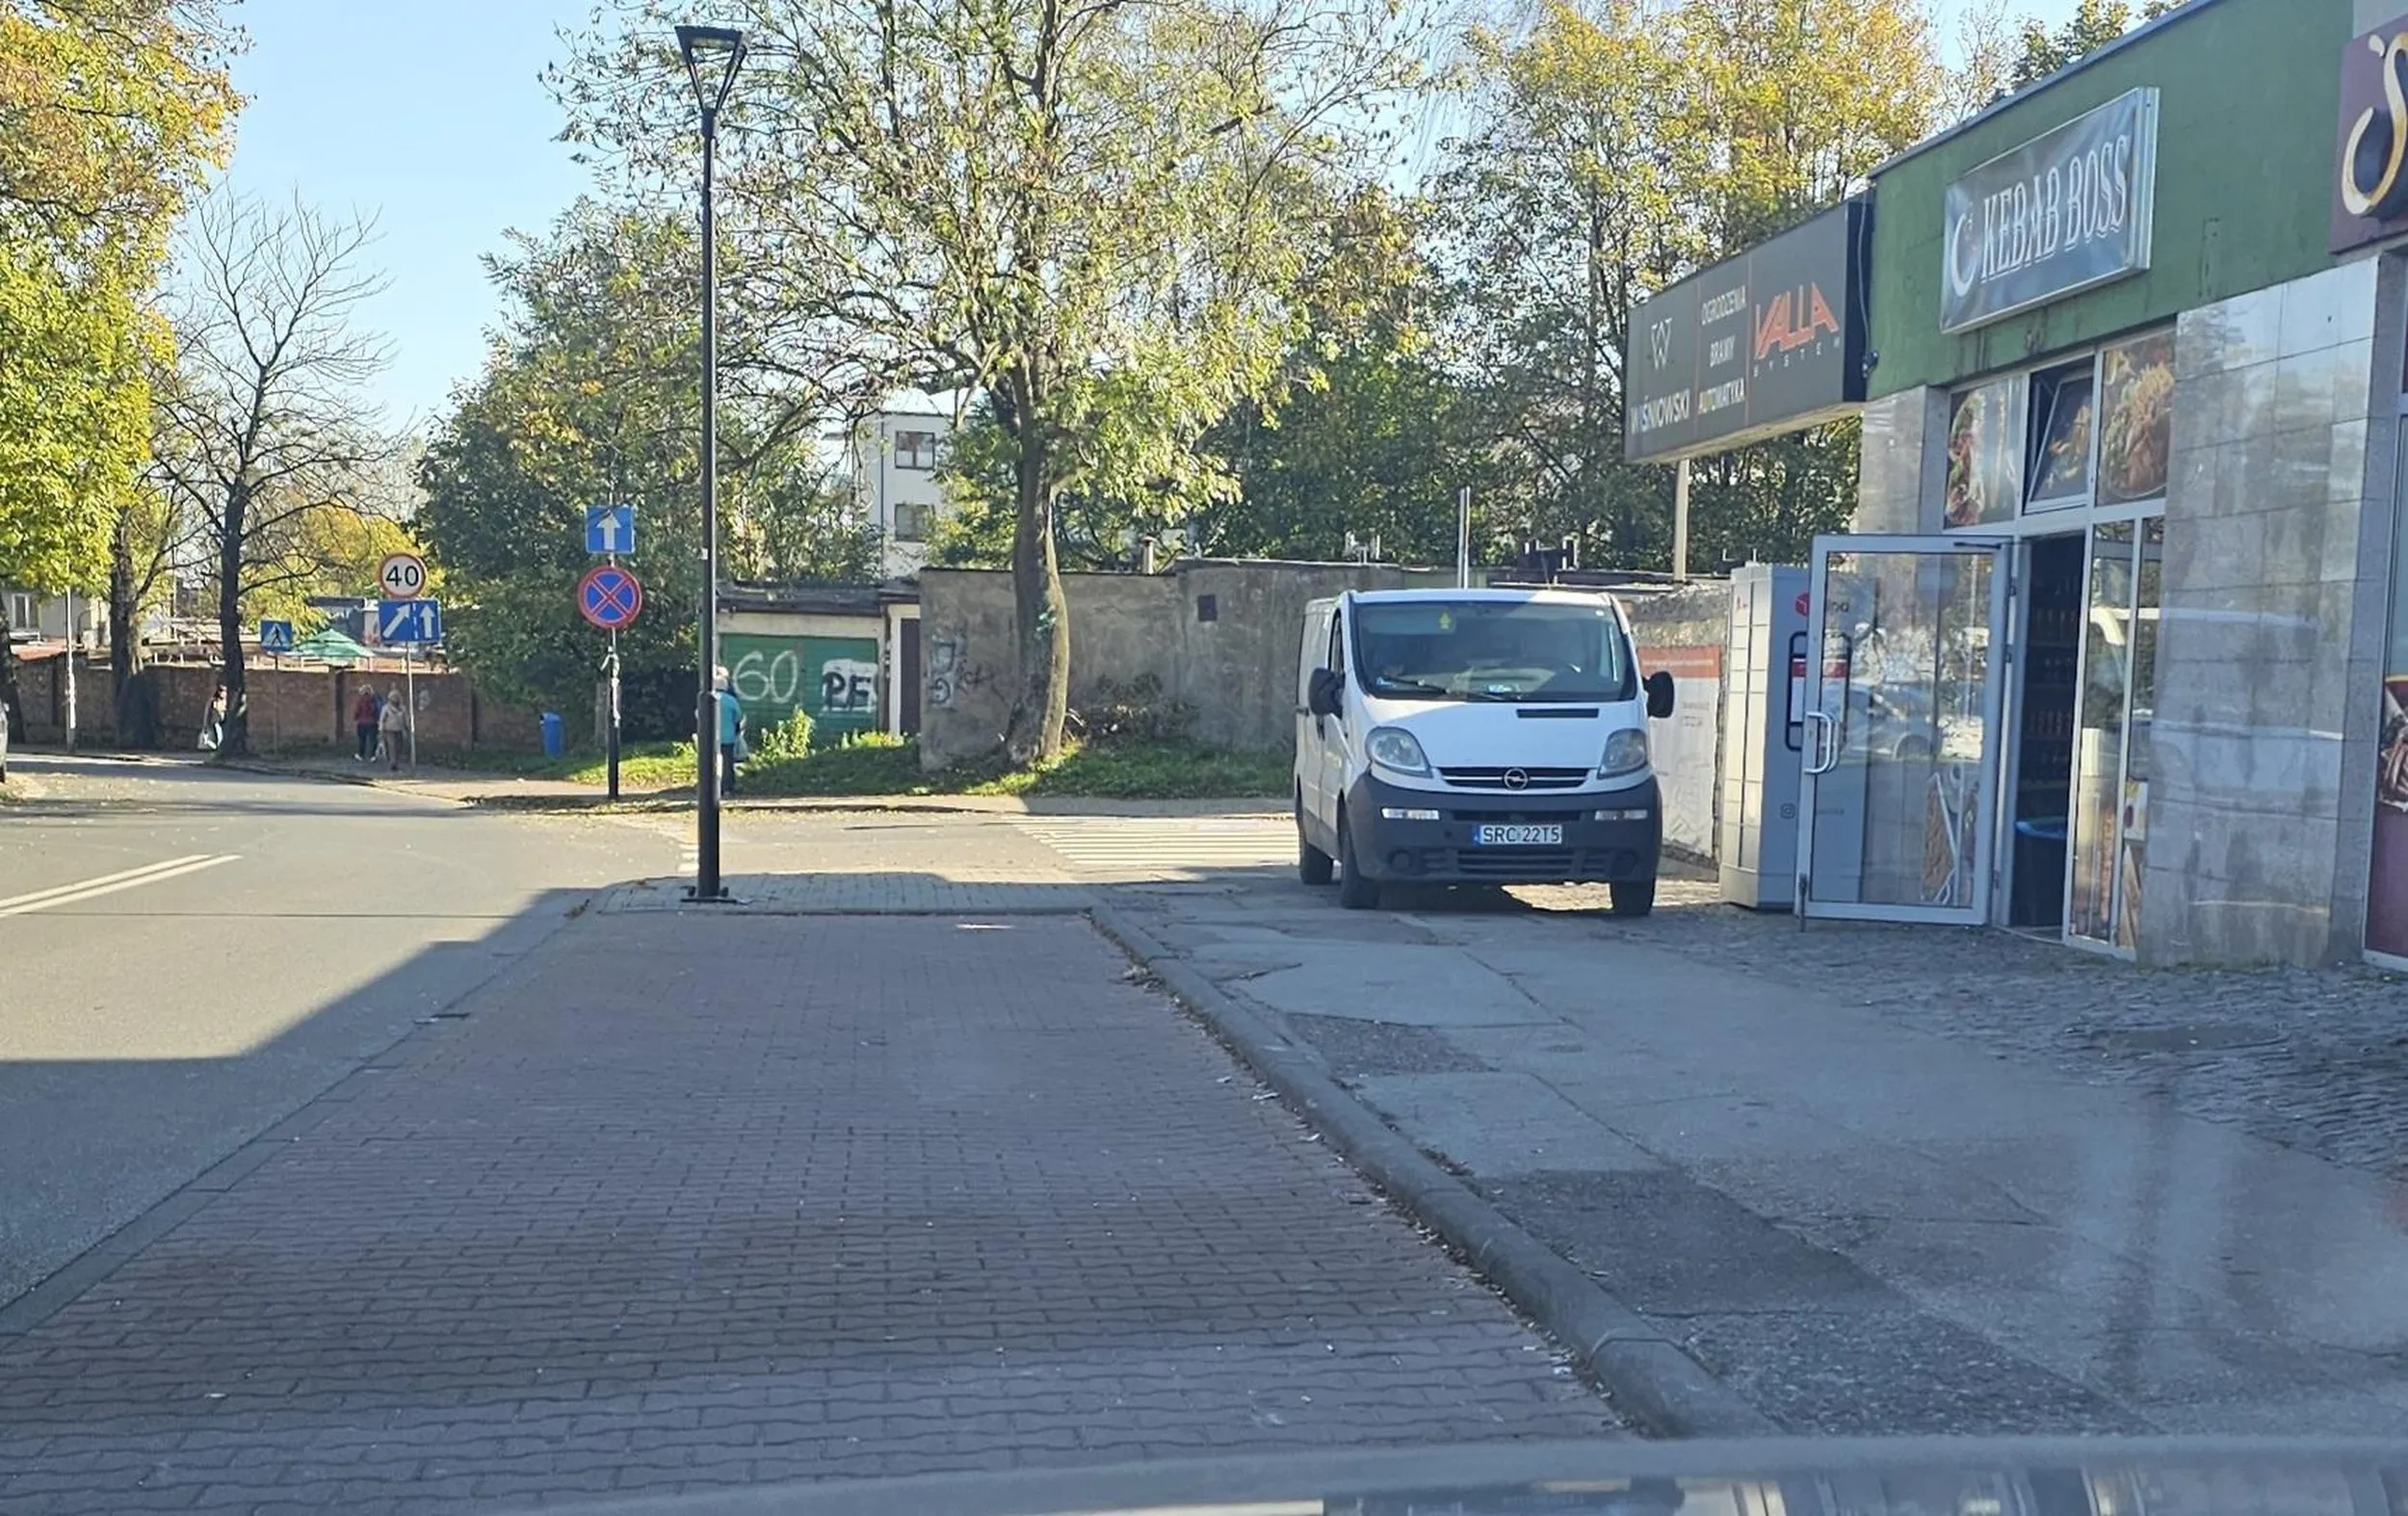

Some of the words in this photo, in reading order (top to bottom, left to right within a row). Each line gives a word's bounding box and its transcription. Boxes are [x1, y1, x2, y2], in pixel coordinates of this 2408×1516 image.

[1980, 166, 2060, 280] KEBAB
[2064, 134, 2131, 248] BOSS
[1753, 280, 1840, 360] VALLA
[1710, 335, 1736, 368] BRAMY
[385, 564, 419, 587] 40
[733, 650, 798, 703] 60
[1483, 826, 1517, 843] SRC
[1522, 826, 1559, 843] 22T5
